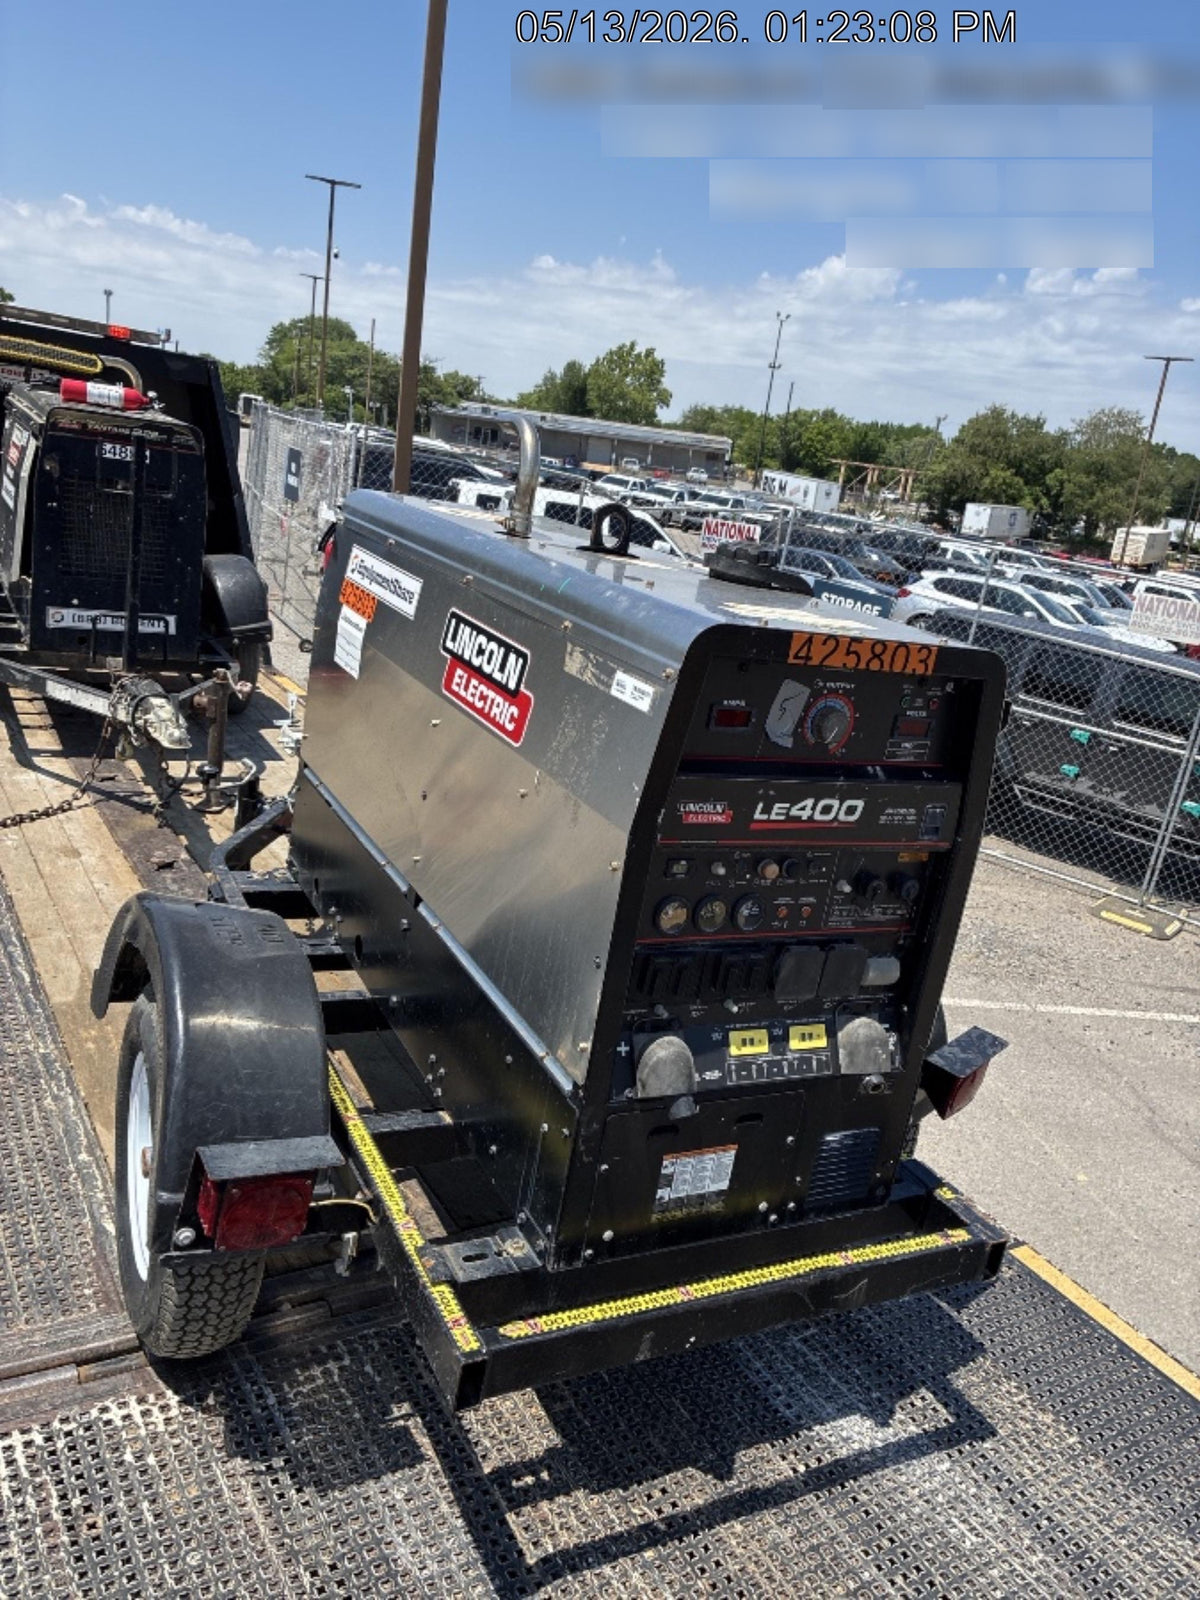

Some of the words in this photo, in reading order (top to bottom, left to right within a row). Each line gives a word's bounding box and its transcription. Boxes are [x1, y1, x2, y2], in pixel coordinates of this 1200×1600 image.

[703, 519, 758, 542] NATIONAL
[820, 591, 882, 617] STORAGE
[1135, 594, 1200, 623] NATIONA
[445, 617, 524, 692] LINCOLN
[792, 632, 934, 675] 425803
[452, 667, 520, 733] ELECTRIC
[679, 802, 725, 814] LINCOLN
[753, 797, 866, 822] LE400
[543, 1313, 565, 1329] DO
[567, 1308, 596, 1325] NOT
[599, 1300, 643, 1318] STAND
